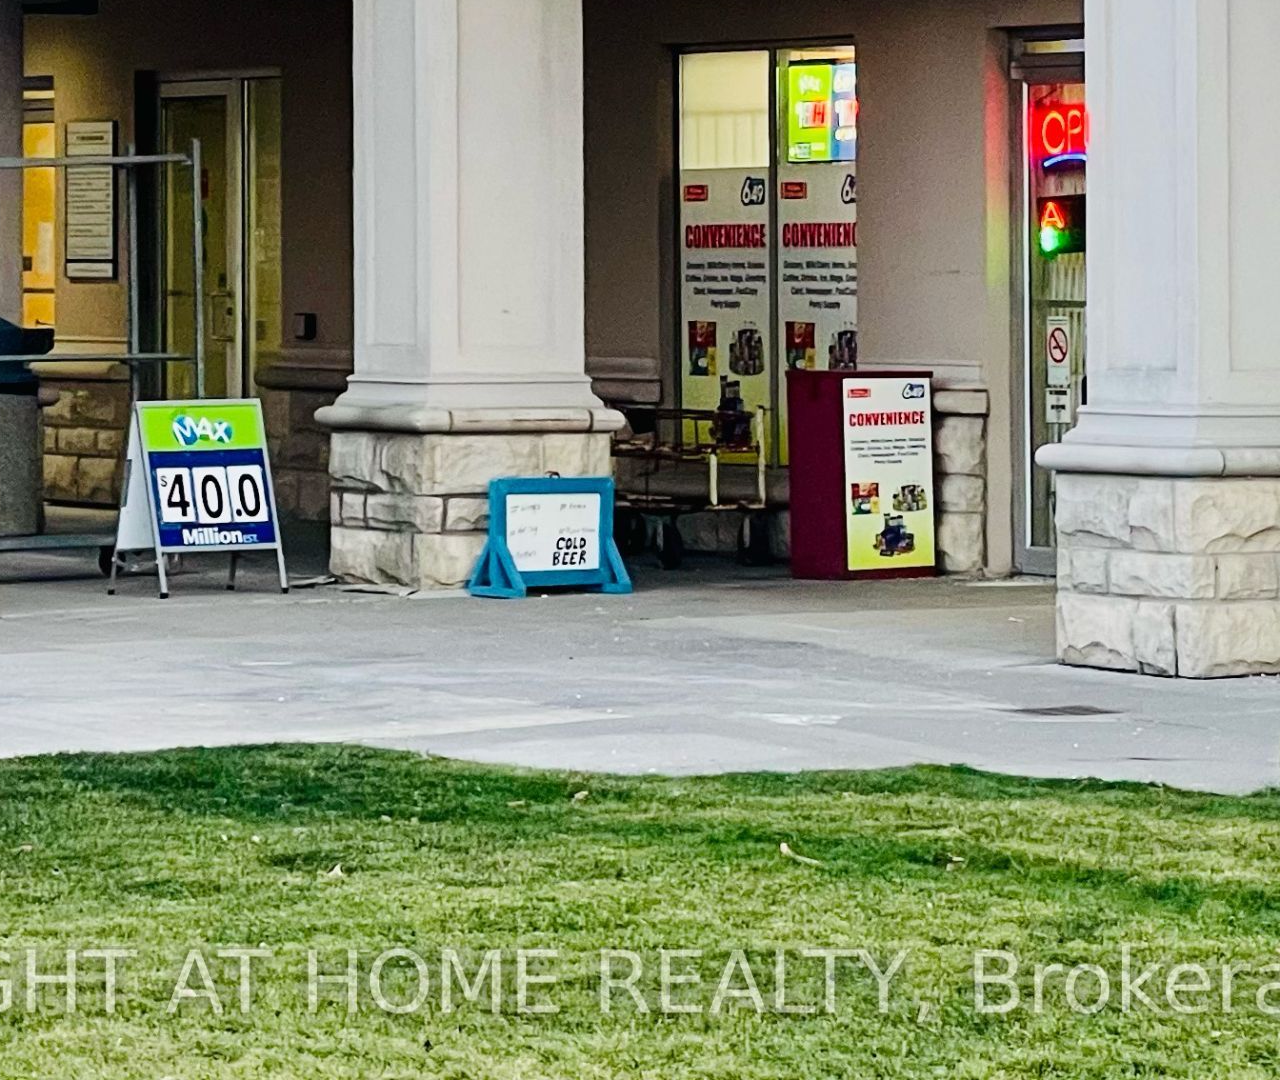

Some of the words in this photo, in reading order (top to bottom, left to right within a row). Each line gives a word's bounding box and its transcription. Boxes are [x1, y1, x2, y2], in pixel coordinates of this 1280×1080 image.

[685, 223, 767, 249] CONVENIENCE
[782, 222, 857, 248] CONVENIENC
[848, 410, 925, 428] CONVENIENCE
[172, 415, 232, 446] MAX
[182, 525, 243, 546] Million
[556, 536, 587, 550] COLD
[552, 550, 587, 566] BEER
